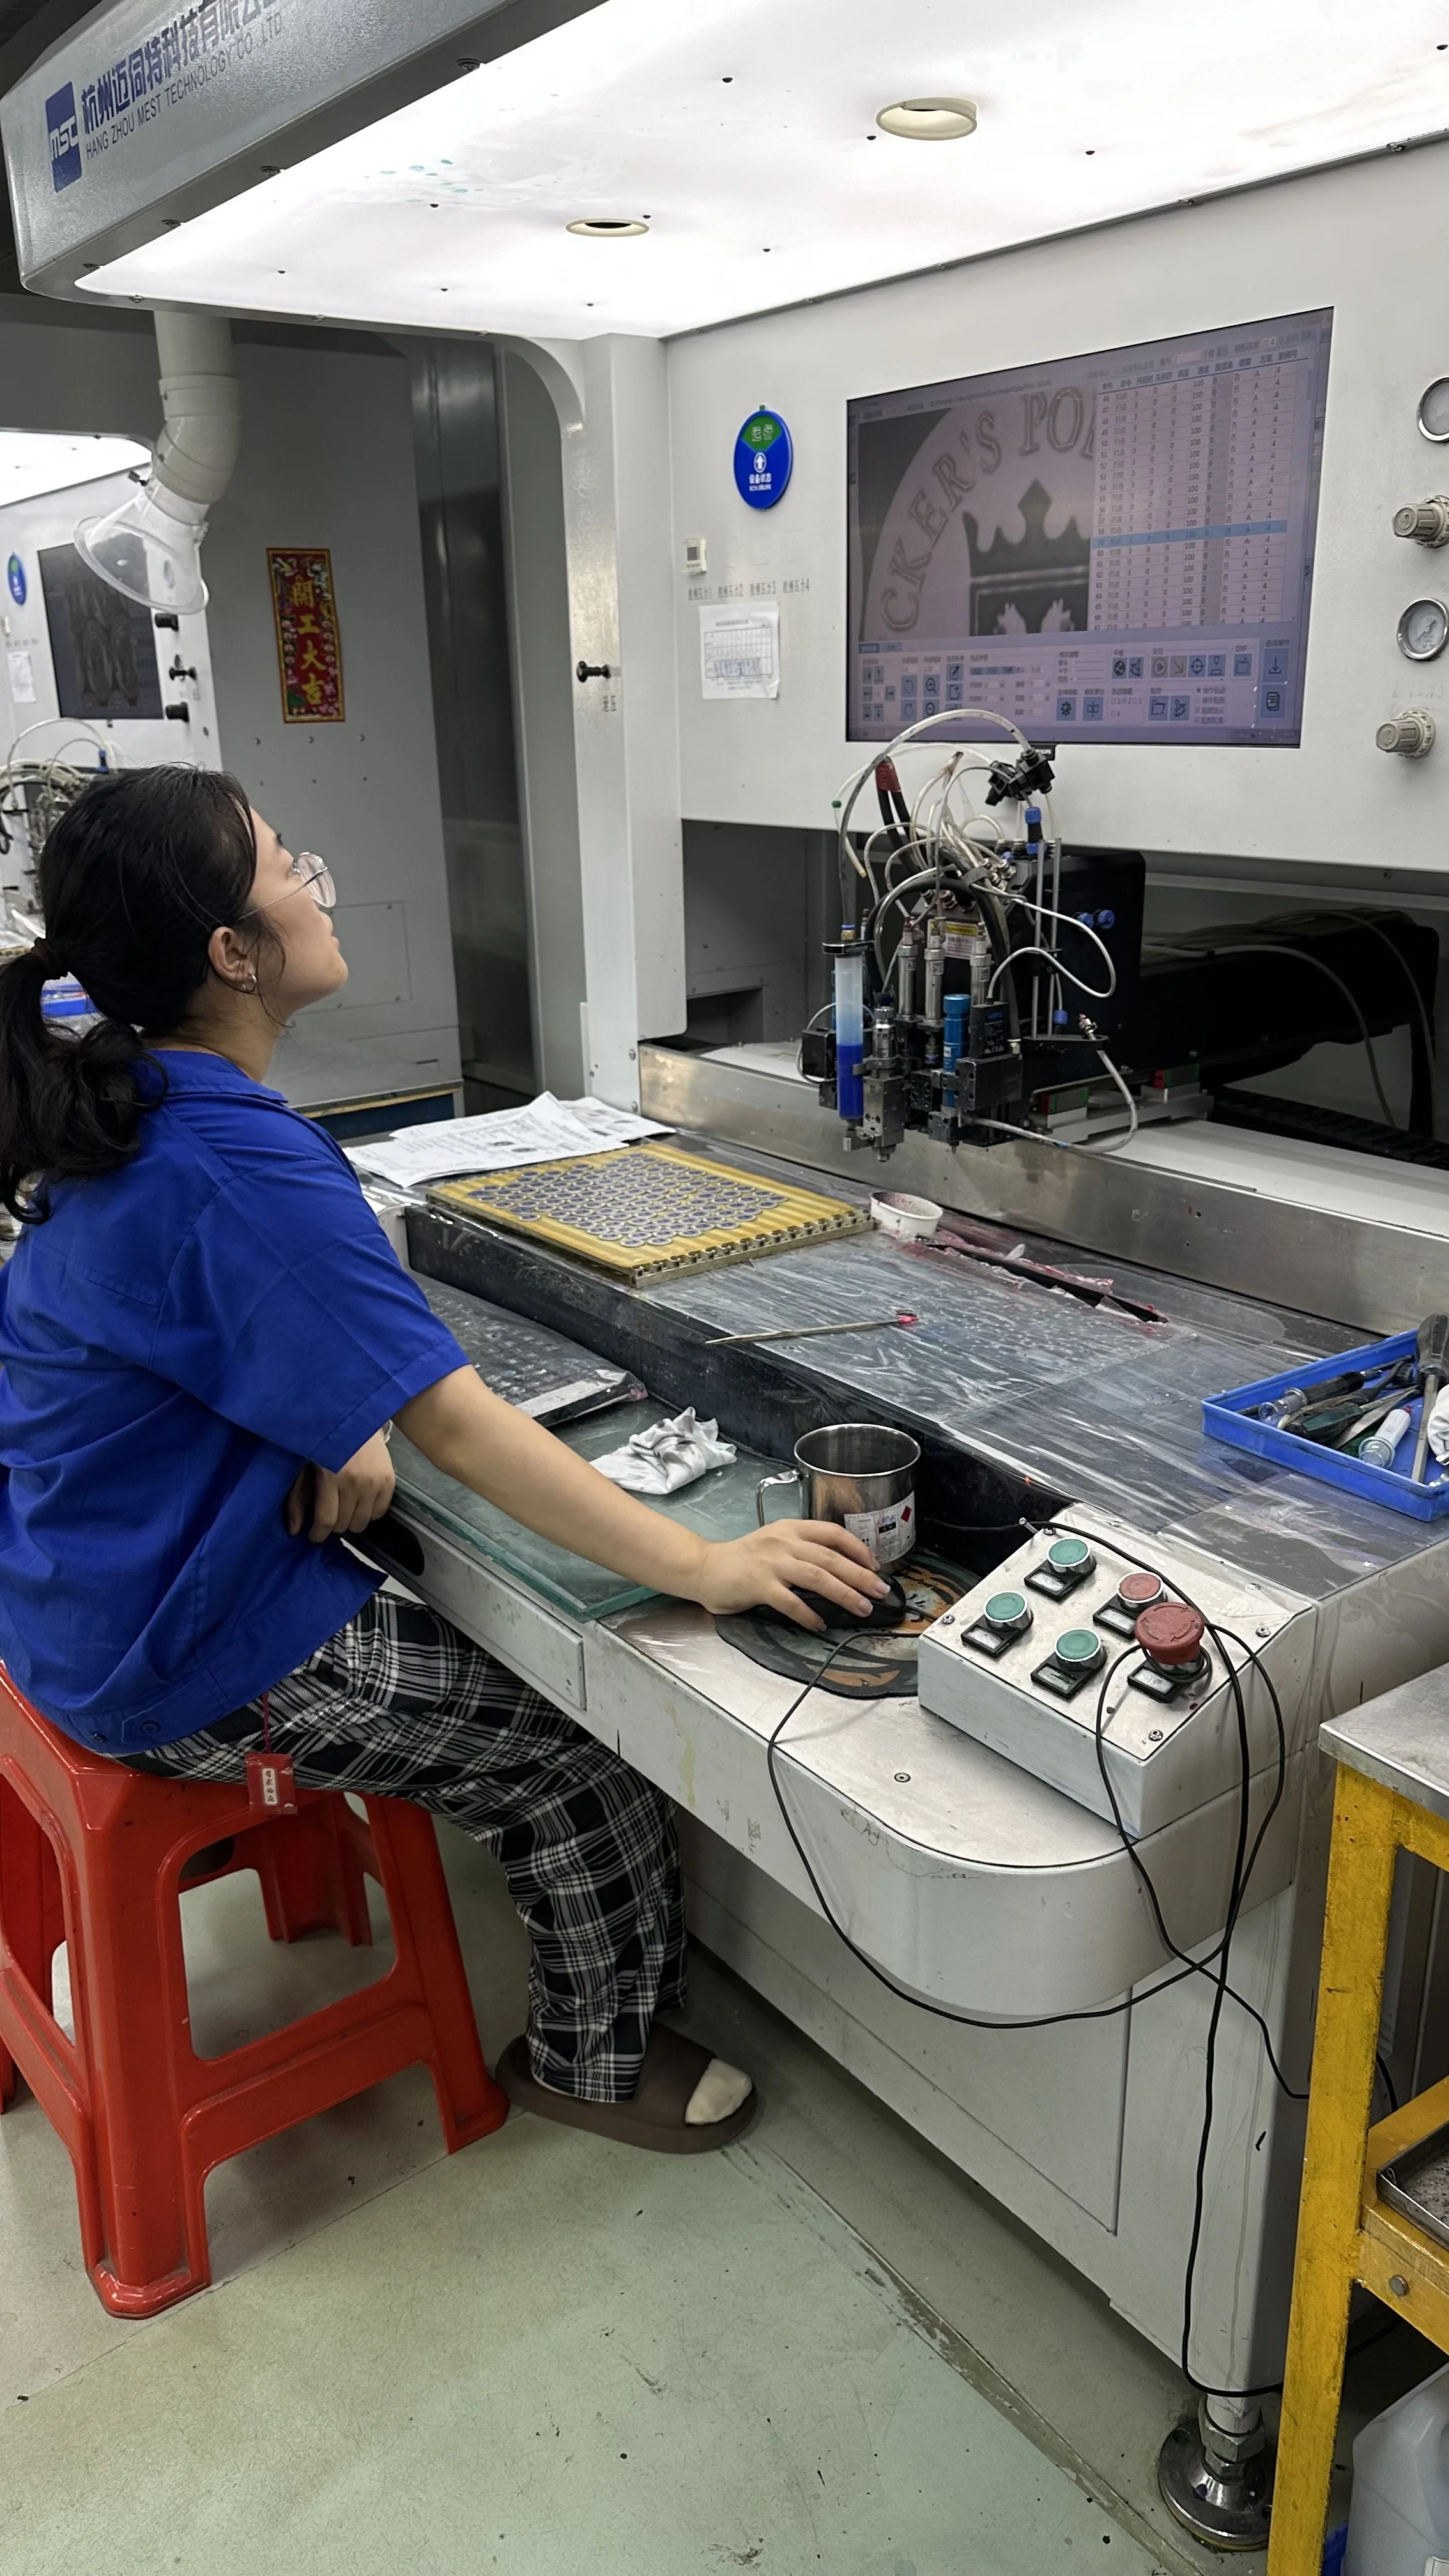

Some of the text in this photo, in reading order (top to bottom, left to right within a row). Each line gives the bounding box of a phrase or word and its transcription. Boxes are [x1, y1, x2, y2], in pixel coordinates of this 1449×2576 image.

[81, 0, 275, 134] 杭州迈伺特科技有限公
[86, 132, 109, 160] HANG
[112, 117, 135, 144] ZHOU
[137, 95, 161, 126] MEST
[164, 45, 233, 108] TECHNOLOGY
[291, 578, 326, 705] 開工大吉
